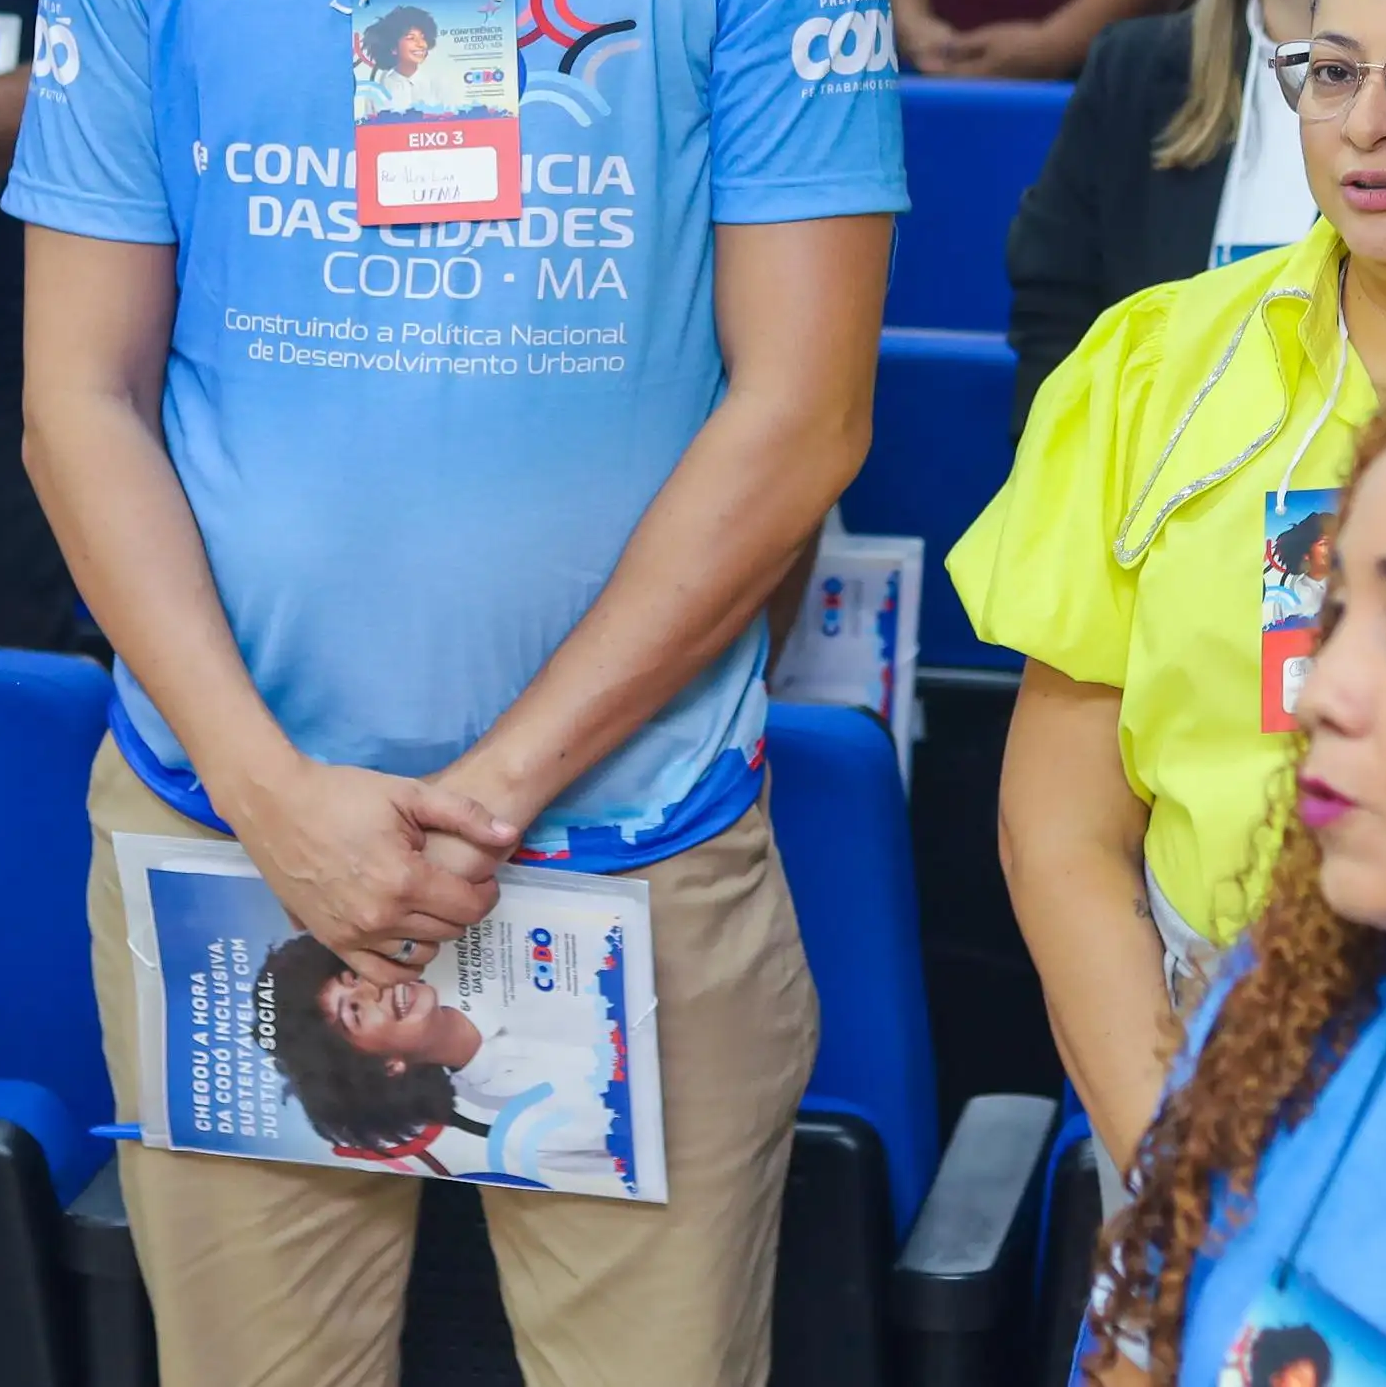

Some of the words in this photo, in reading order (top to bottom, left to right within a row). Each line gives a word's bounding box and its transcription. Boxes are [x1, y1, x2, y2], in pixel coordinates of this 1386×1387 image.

[409, 132, 449, 148] EIXO
[452, 131, 464, 145] 3
[249, 195, 363, 243] DAS
[323, 246, 482, 300] CODÓ
[537, 258, 629, 300] MA
[225, 308, 369, 342] Construindo
[376, 326, 394, 343] a
[401, 322, 502, 347] Política
[511, 322, 627, 347] Nacional
[248, 338, 275, 362] de
[279, 341, 518, 375] Desenvolvimento
[527, 351, 625, 375] Urbano
[230, 938, 251, 976] COM
[470, 924, 483, 968] CIDADE
[190, 972, 210, 1026] HORA
[235, 981, 253, 993] E
[257, 971, 277, 1051] SOCIAL.
[192, 1031, 210, 1047] A
[211, 1047, 232, 1104] CODÓ
[233, 997, 257, 1137] SUSTENTÁVEL
[192, 1050, 212, 1132] CHEGOU
[259, 1056, 279, 1139] JUSTIÇA
[216, 1109, 234, 1134] DA
